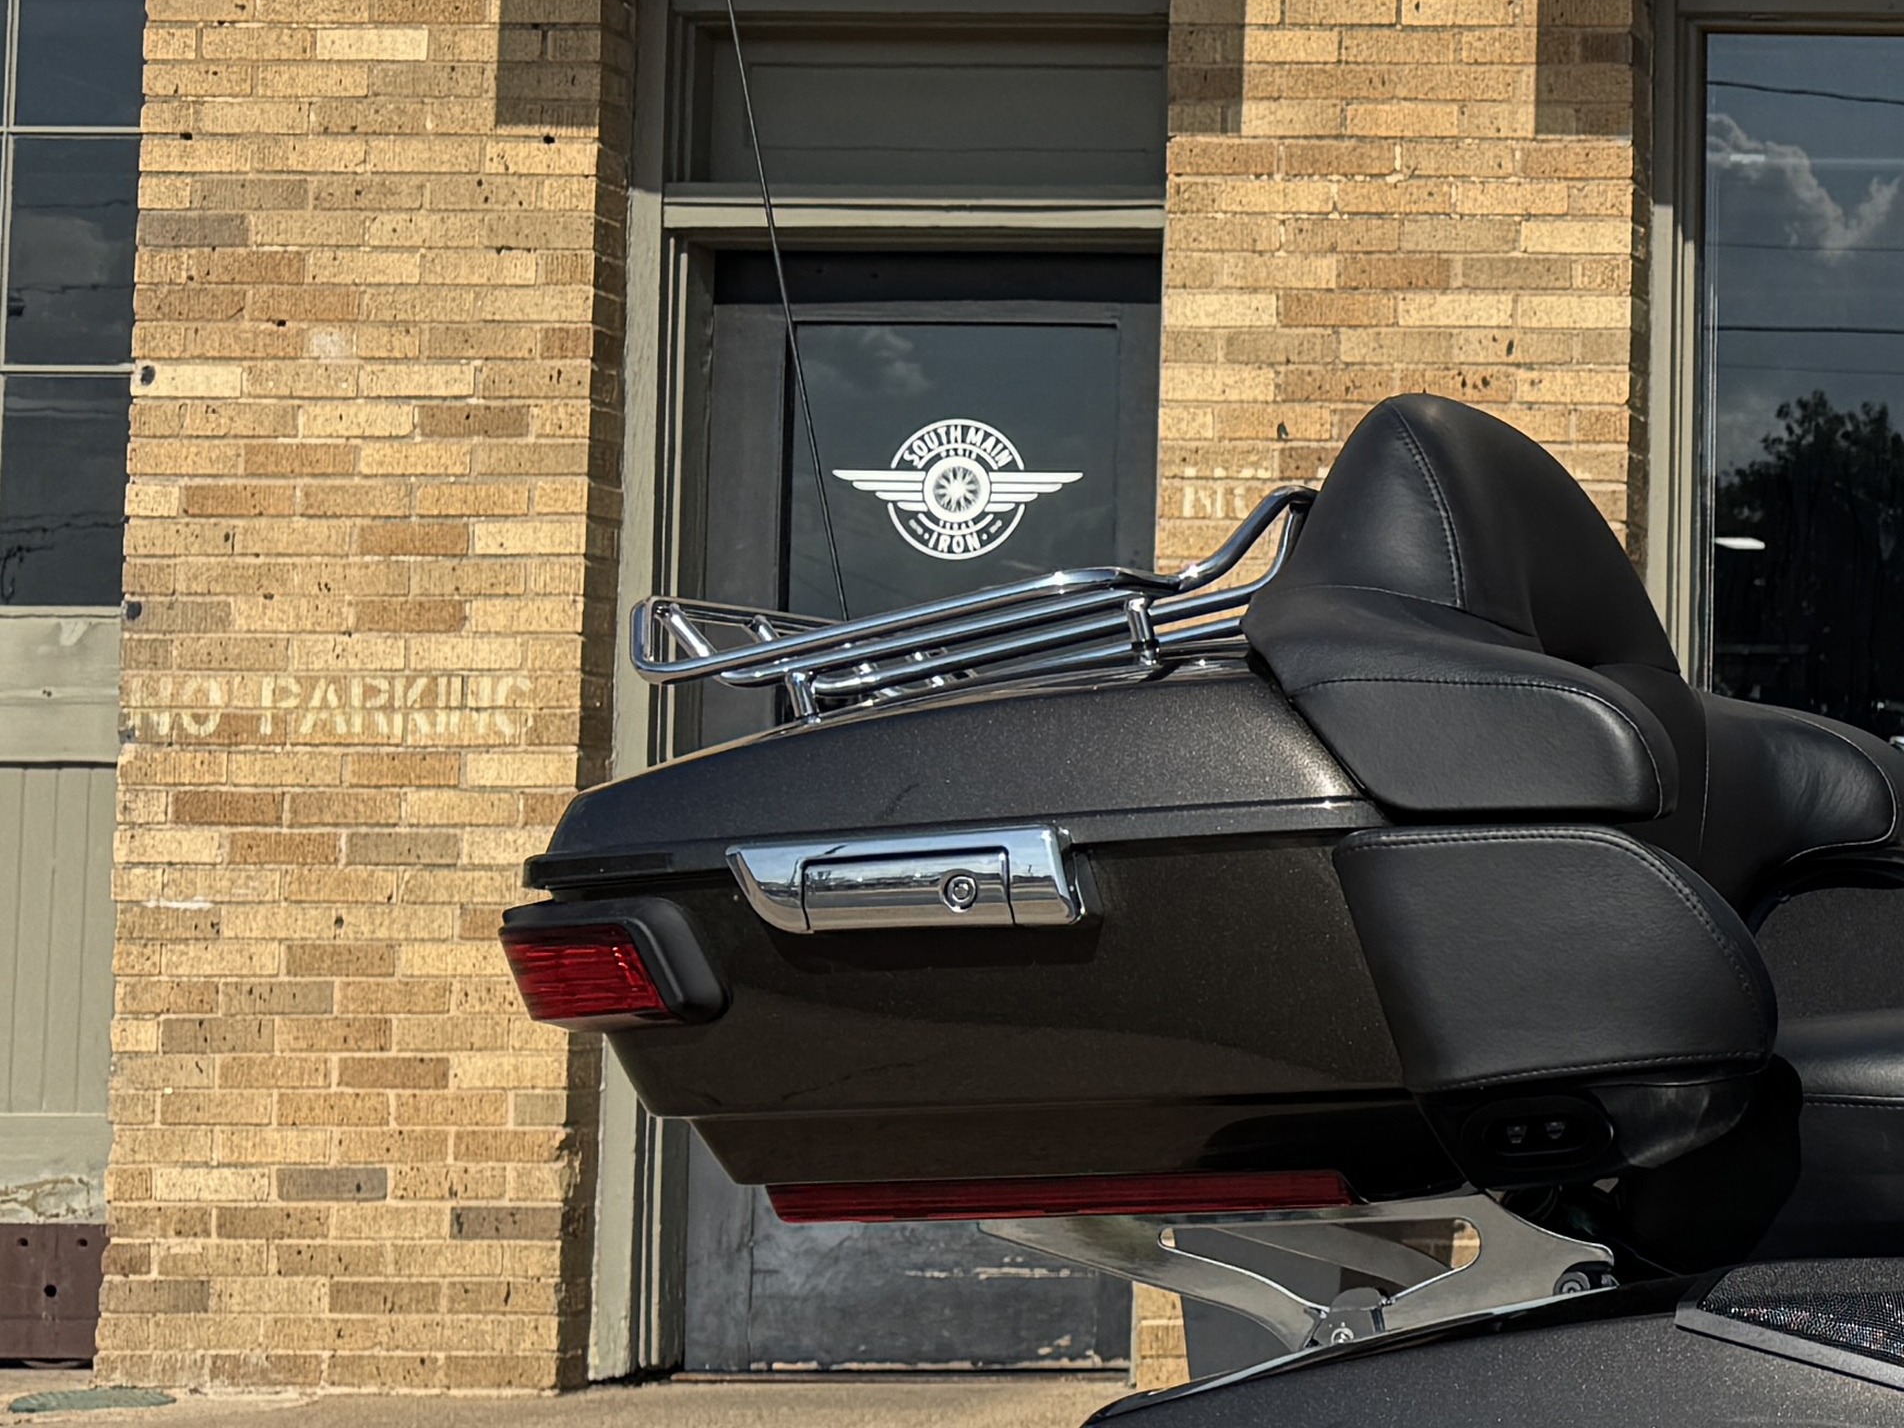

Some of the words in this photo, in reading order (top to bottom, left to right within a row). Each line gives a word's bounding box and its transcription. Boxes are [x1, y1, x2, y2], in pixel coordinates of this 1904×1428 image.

[903, 424, 961, 467] SOUTH
[965, 426, 1013, 467] MAIN
[928, 531, 981, 554] IRON
[127, 674, 222, 737] NO
[262, 674, 533, 736] PARKING
